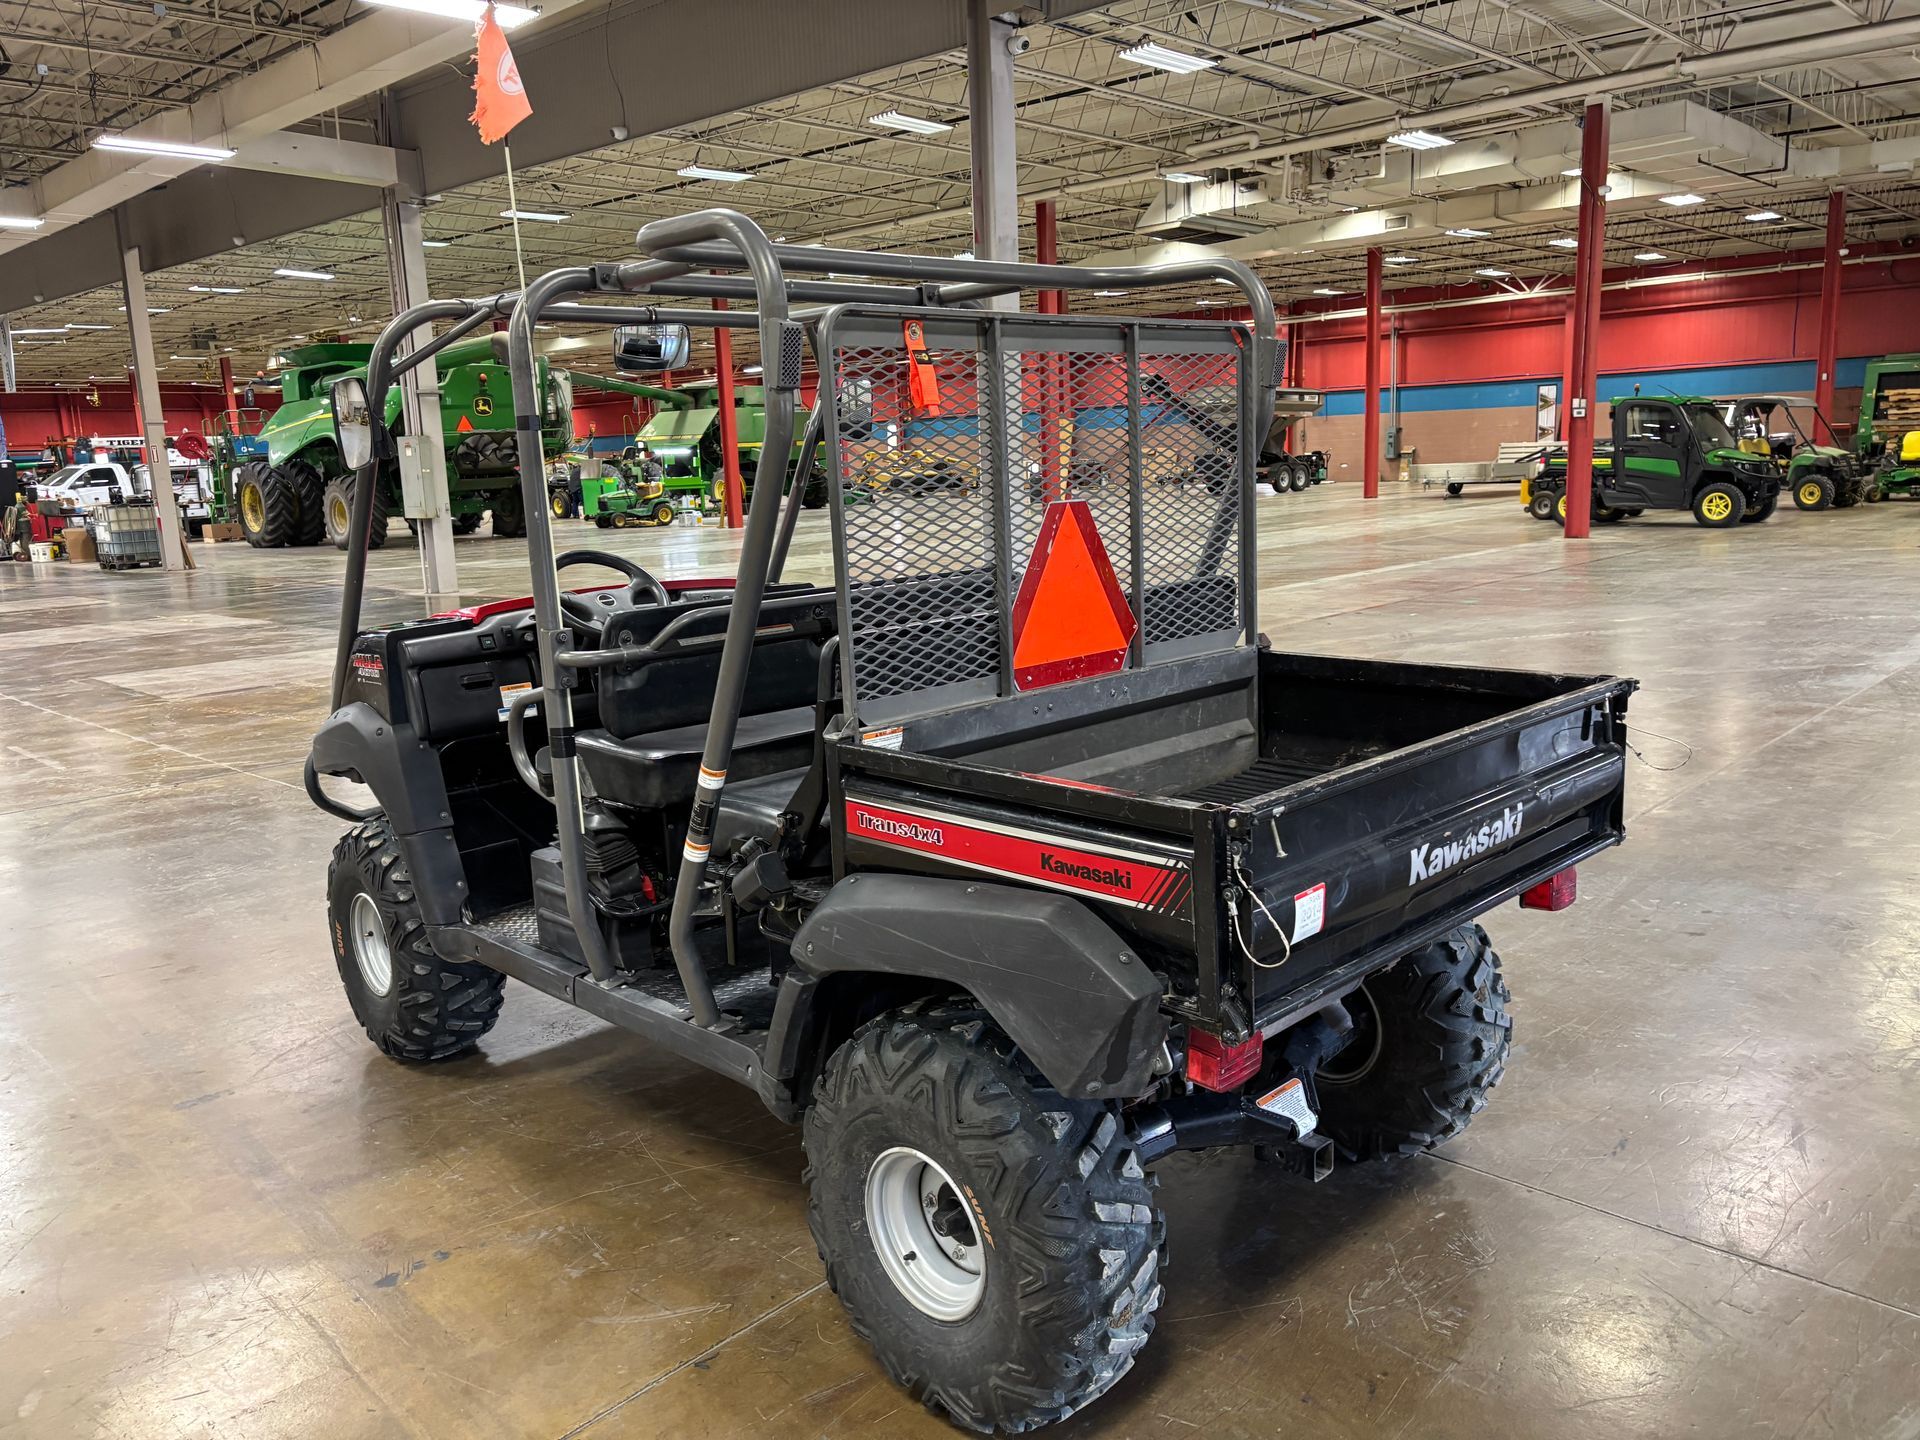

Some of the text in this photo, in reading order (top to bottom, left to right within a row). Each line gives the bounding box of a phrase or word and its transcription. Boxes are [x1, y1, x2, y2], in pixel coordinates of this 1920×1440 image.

[856, 810, 944, 846] Trans4x4
[1408, 801, 1524, 887] Kawasaki
[1040, 852, 1132, 890] Kawasaki
